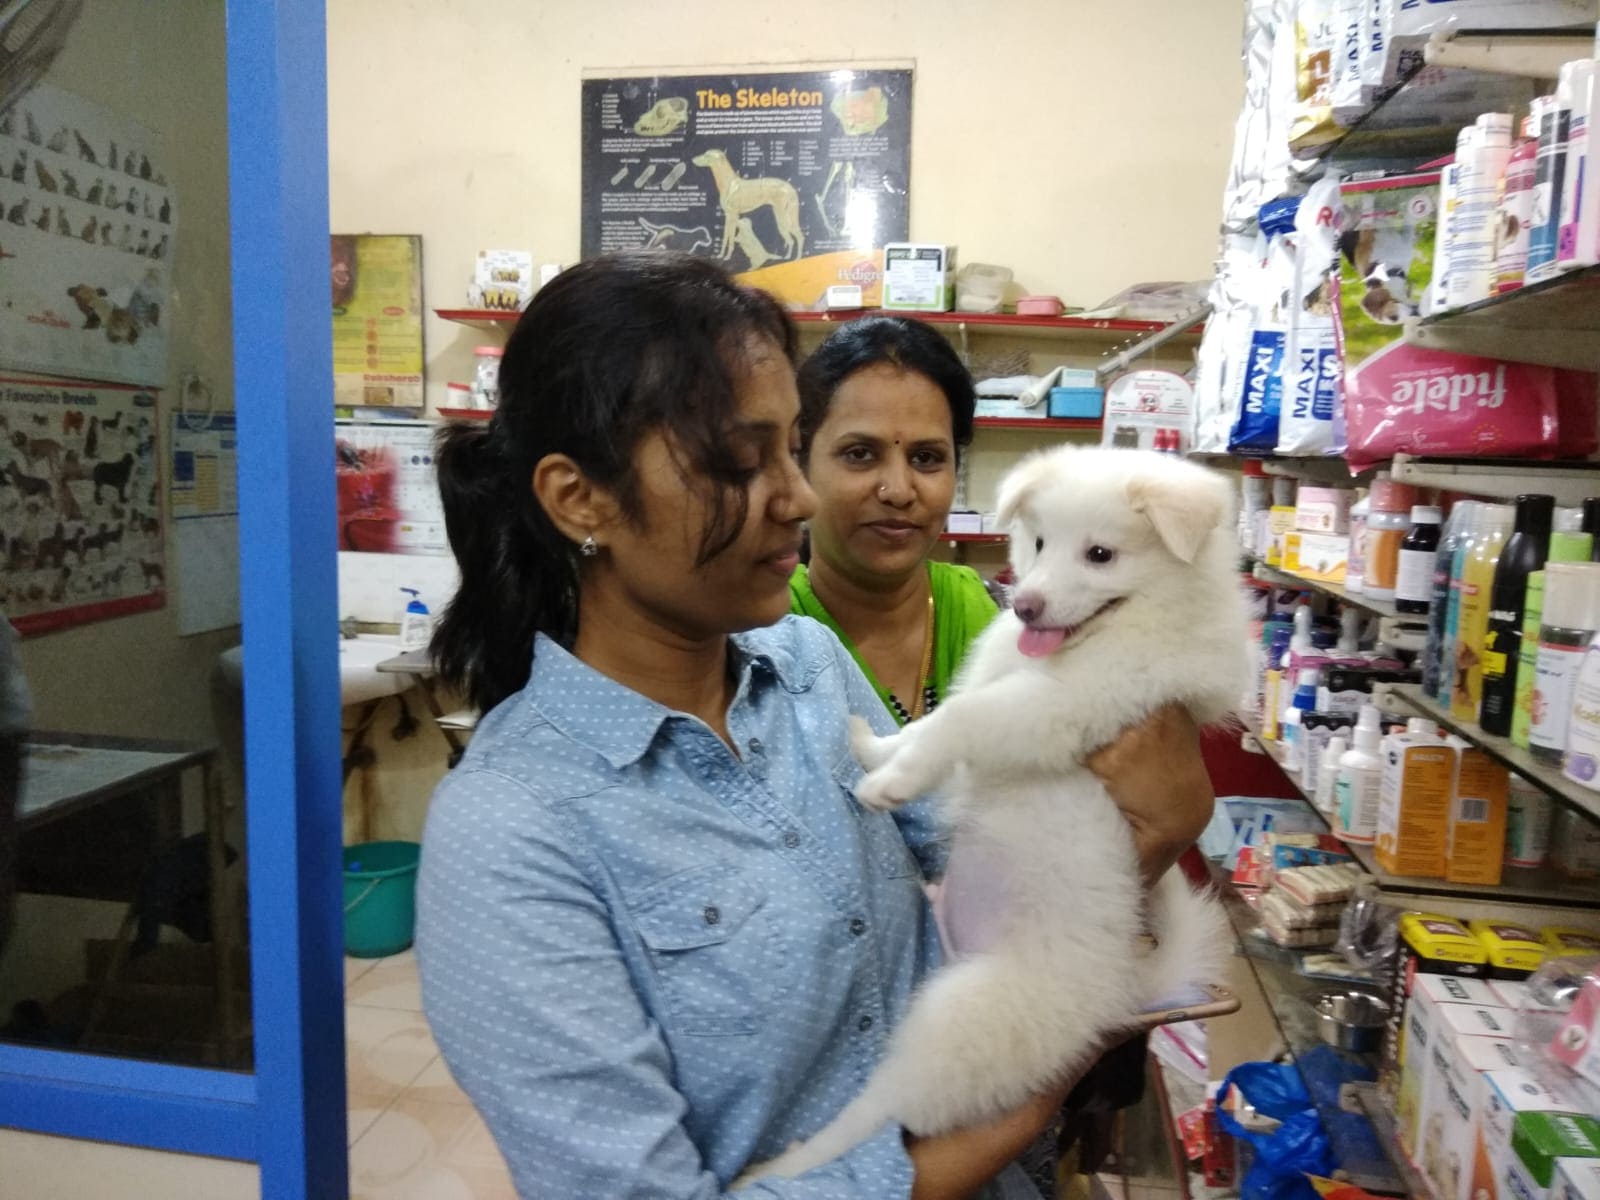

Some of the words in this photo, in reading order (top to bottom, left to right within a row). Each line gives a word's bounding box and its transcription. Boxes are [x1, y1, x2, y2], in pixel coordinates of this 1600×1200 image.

[696, 89, 732, 109] The
[736, 87, 824, 109] Skeleton
[837, 267, 884, 284] Pedigre
[1246, 347, 1275, 413] MAXI
[1293, 348, 1316, 418] MAXI
[1392, 365, 1508, 413] fidèle
